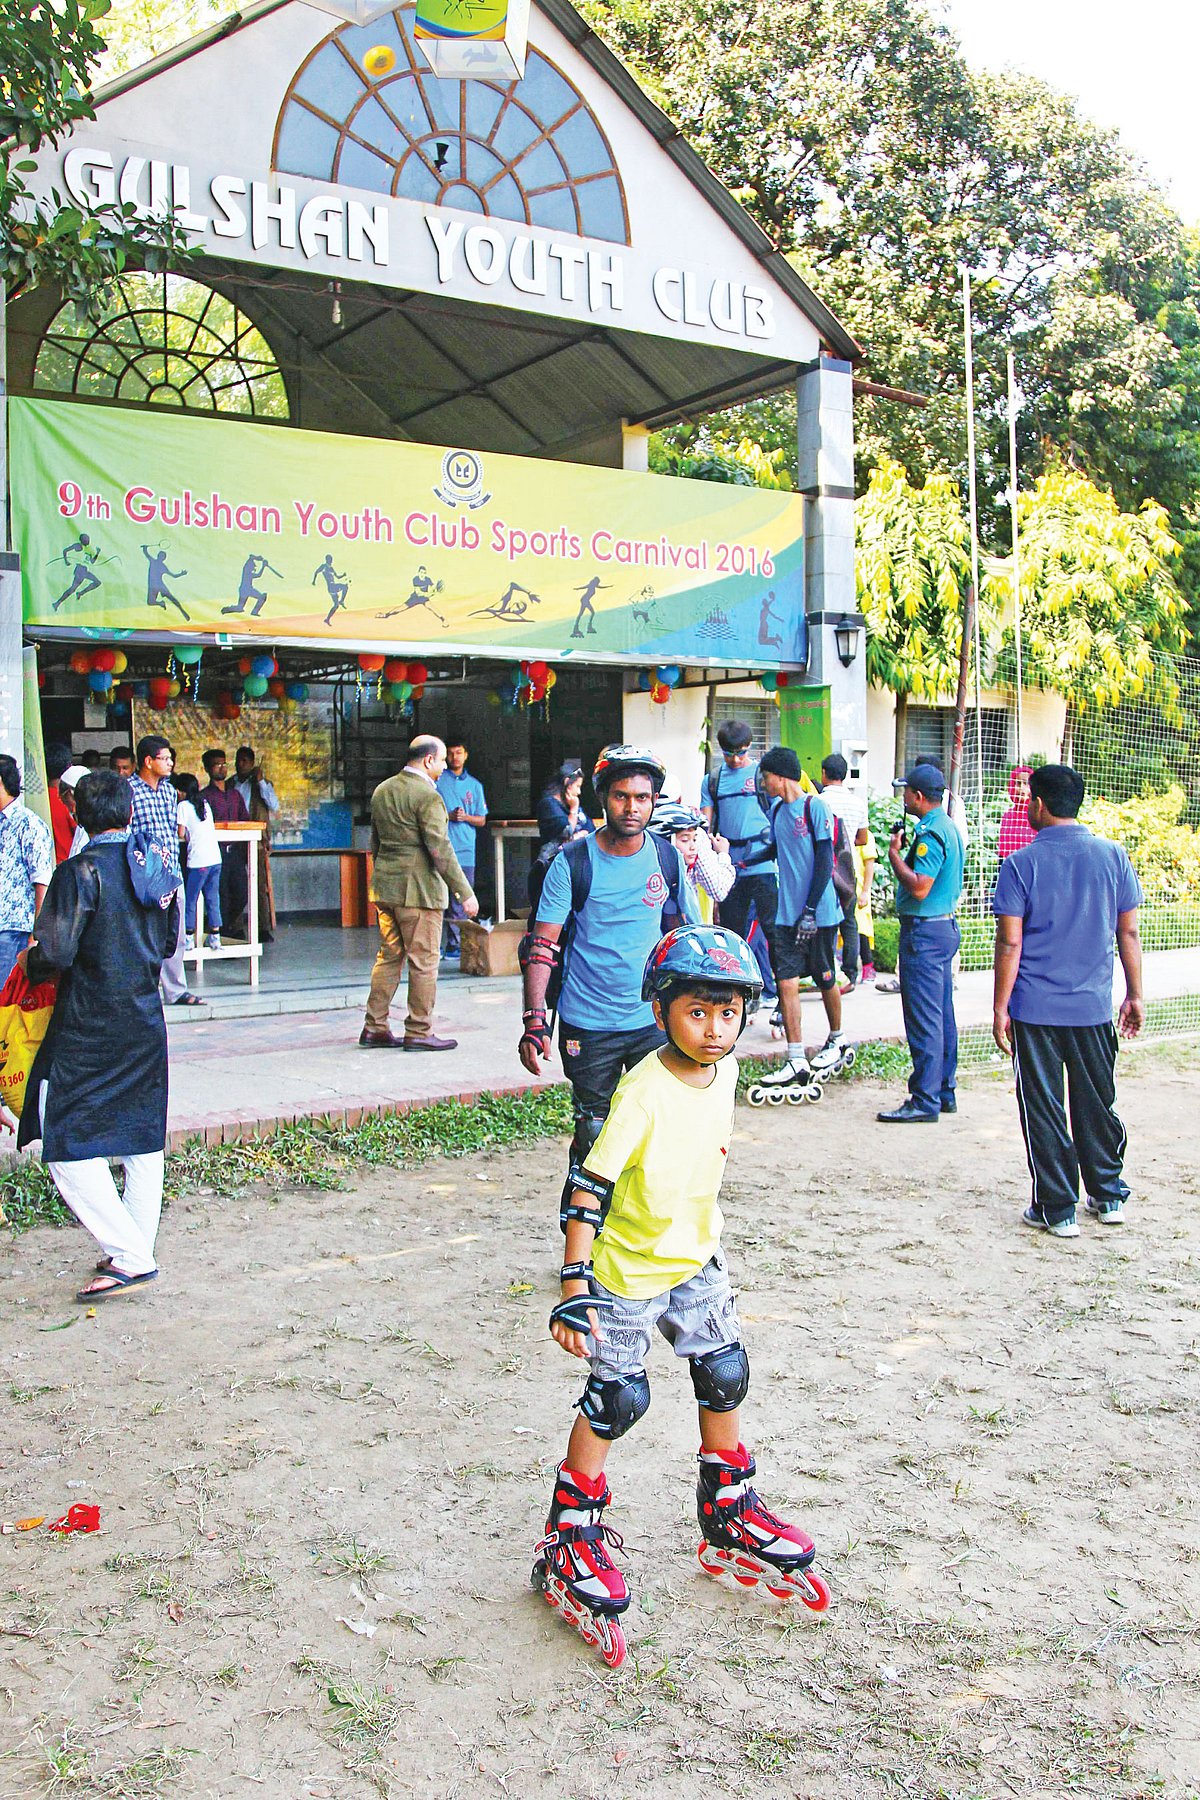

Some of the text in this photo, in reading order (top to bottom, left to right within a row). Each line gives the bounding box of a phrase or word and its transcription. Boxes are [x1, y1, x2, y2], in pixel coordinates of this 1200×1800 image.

[63, 147, 777, 340] GULSHAN YOUTH CLUB
[58, 481, 775, 577] 9th Gulshan Youth Club Sports Carnival 2016
[8, 1070, 25, 1087] 360
